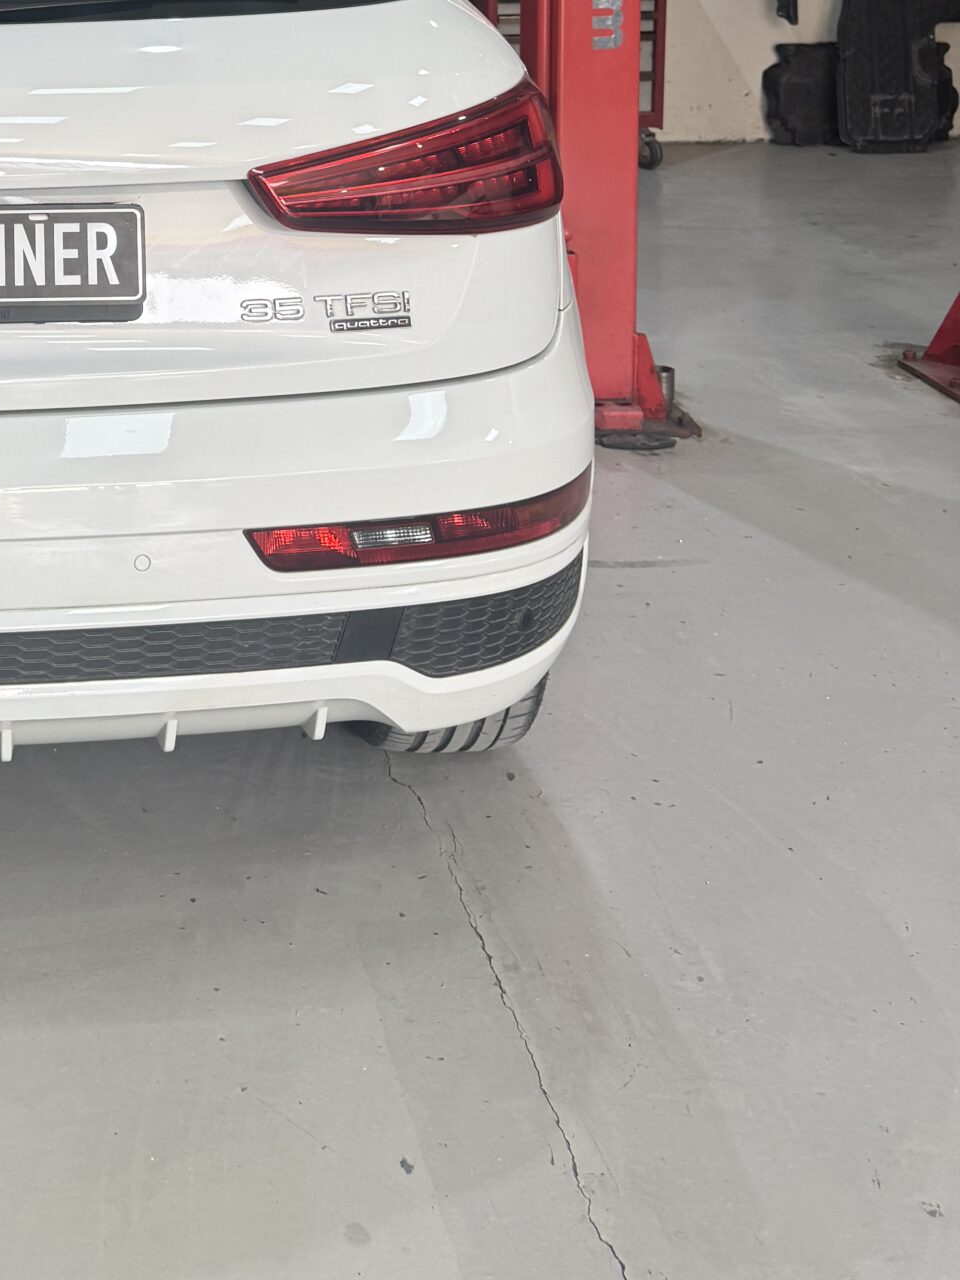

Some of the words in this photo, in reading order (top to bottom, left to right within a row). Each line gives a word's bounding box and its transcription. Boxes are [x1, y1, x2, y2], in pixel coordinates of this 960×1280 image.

[240, 296, 305, 322] 35
[313, 291, 411, 318] TFSI
[334, 318, 410, 331] quattro
